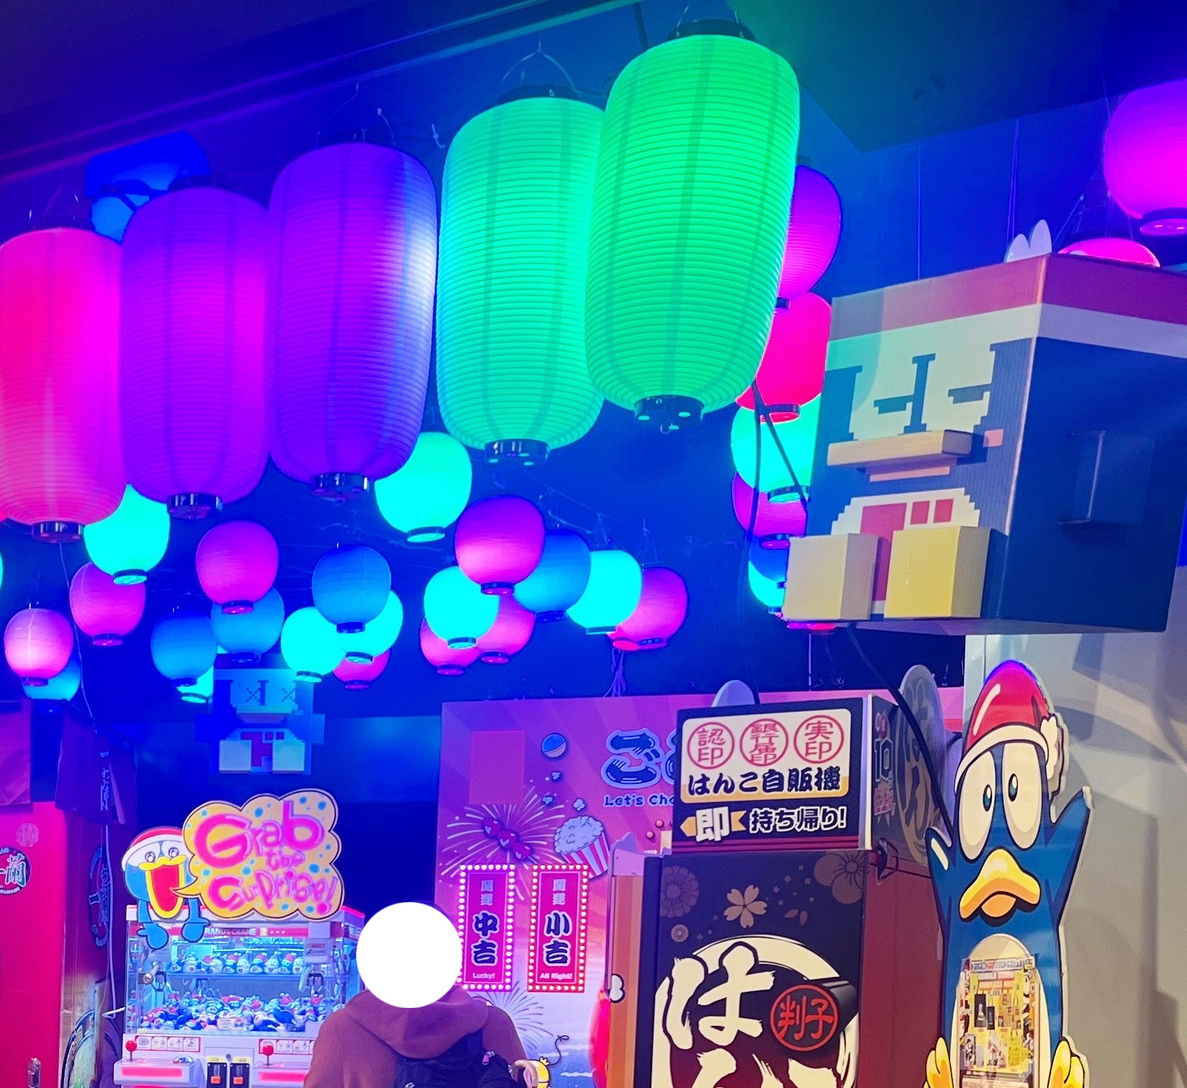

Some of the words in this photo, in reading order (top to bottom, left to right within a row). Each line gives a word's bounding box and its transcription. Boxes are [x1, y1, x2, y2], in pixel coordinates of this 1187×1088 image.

[697, 728, 726, 765] 認印
[804, 720, 834, 759] 実印
[688, 766, 841, 796] はんこ自販機
[195, 800, 325, 869] Grab
[696, 807, 730, 842] 即
[749, 806, 847, 833] 持ち帰り!
[266, 850, 306, 871] the
[473, 911, 499, 965] 中吉
[545, 911, 571, 965] 小吉
[778, 994, 836, 1041] 判子
